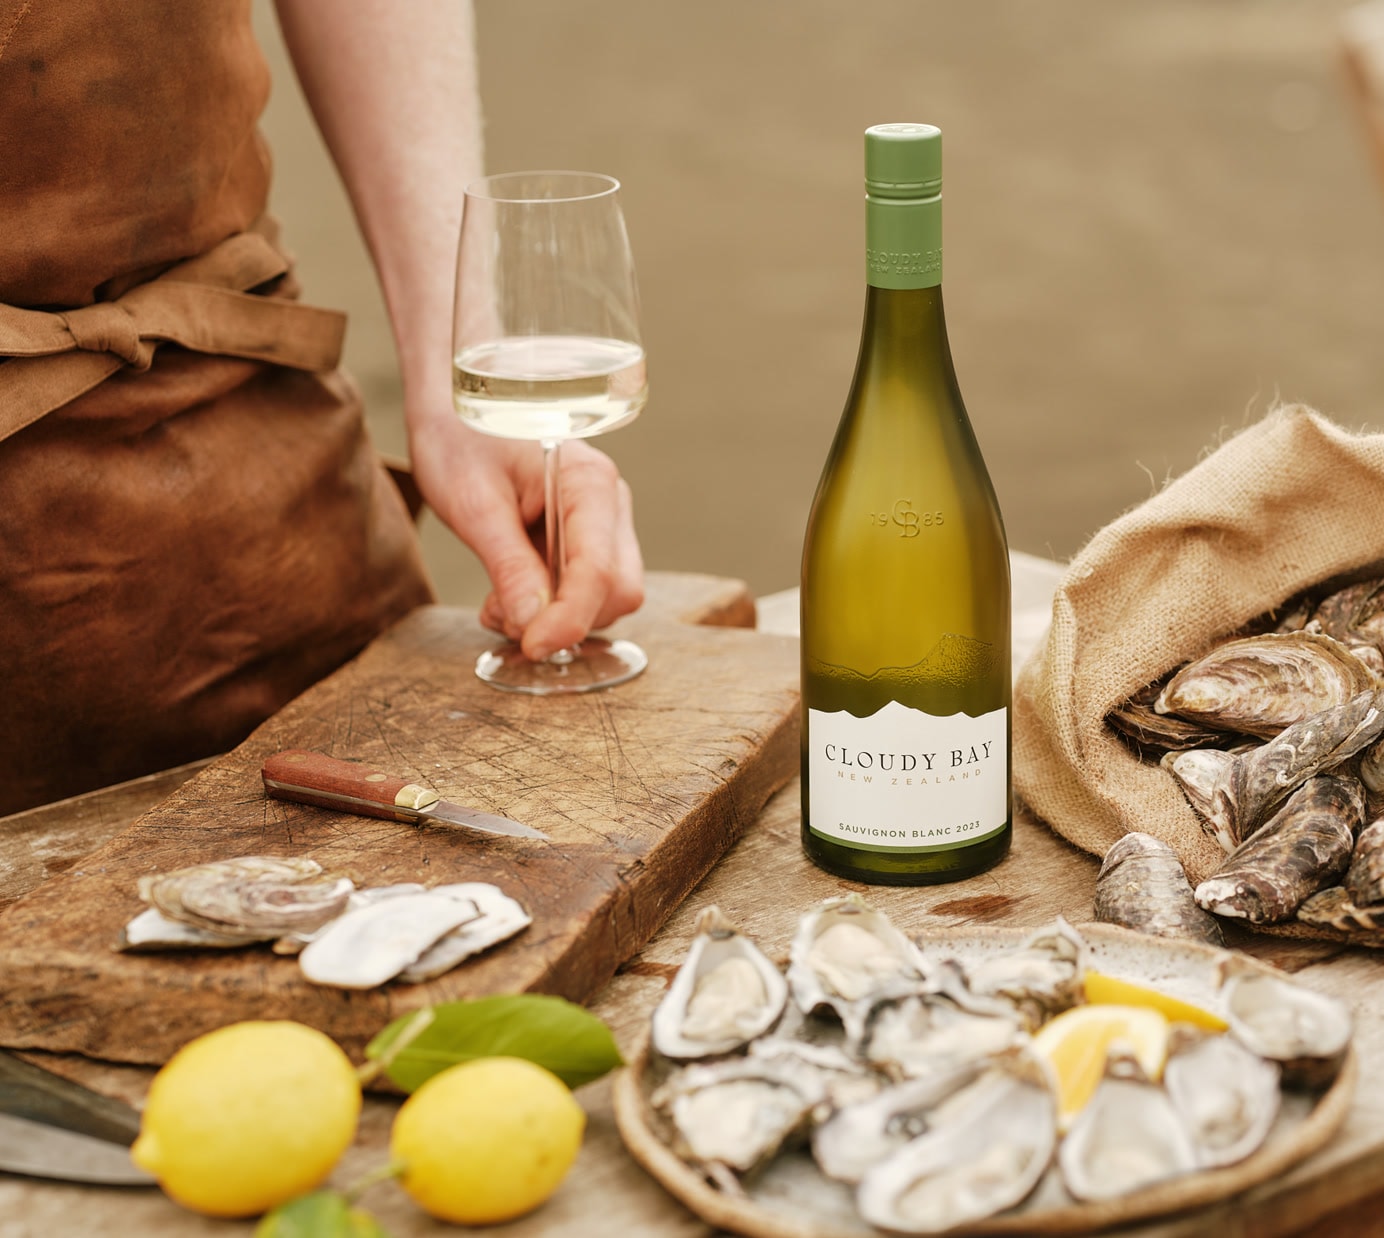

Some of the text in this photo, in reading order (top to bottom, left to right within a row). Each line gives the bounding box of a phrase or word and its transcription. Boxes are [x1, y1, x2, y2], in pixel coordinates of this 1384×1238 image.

[825, 740, 992, 771] CLOUDY BAY
[837, 768, 981, 785] NEW ZEALAND
[839, 820, 981, 838] SAUVIGNON BLANC 2023
